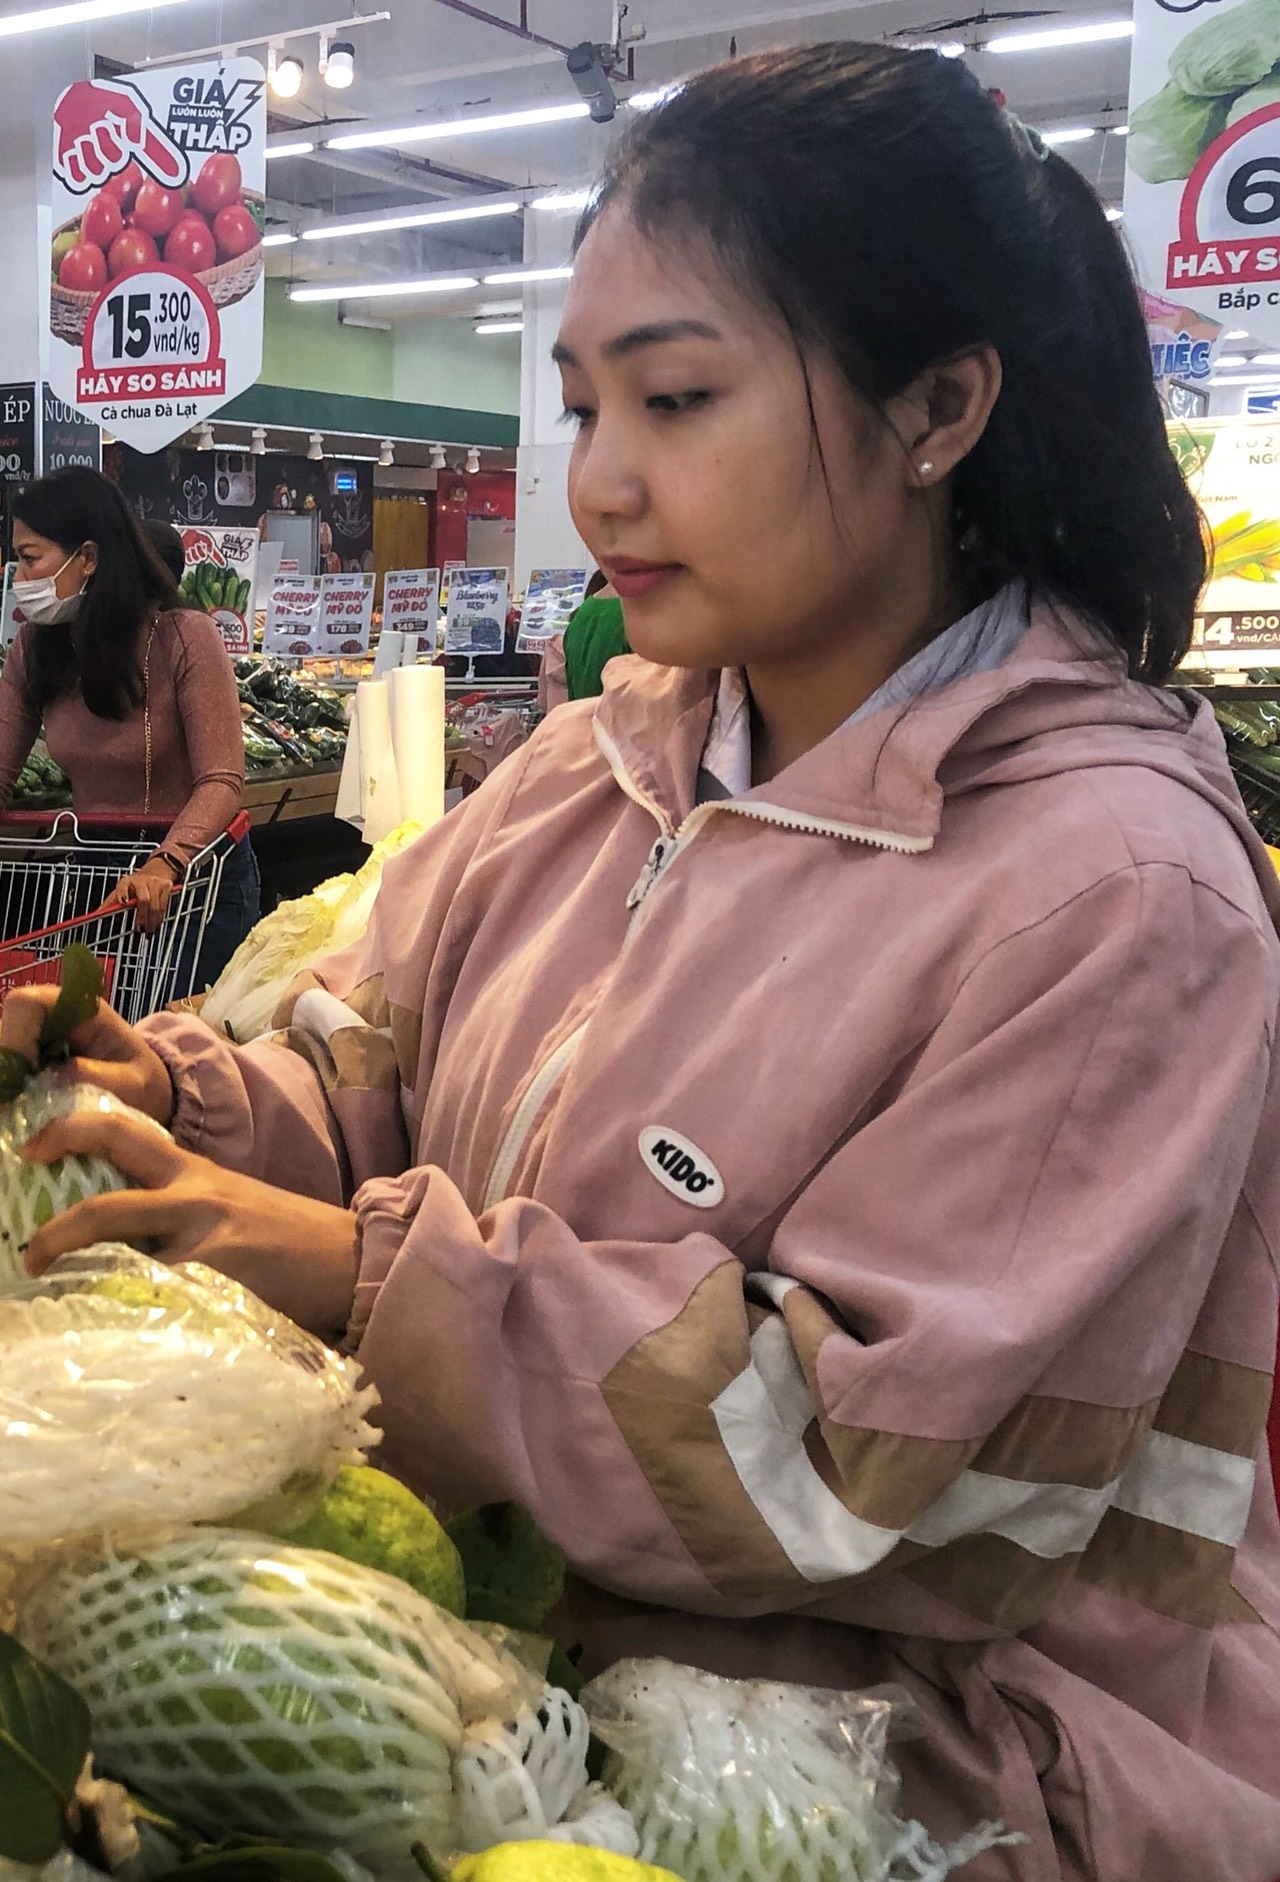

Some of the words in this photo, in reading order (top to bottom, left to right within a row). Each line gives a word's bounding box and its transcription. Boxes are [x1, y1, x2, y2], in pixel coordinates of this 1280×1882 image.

[173, 67, 227, 105] GIÁ
[171, 105, 197, 117] LUÔN
[197, 106, 223, 119] LUÔN
[1172, 247, 1250, 279] HÃY
[1255, 247, 1280, 272] S
[1218, 287, 1260, 310] Bắp
[107, 293, 151, 359] 15
[153, 324, 200, 356] vnd/kg
[80, 372, 124, 396] HÃY
[127, 373, 157, 393] SO
[160, 367, 222, 391] SÁNH
[4, 394, 31, 423] ÉP
[101, 404, 117, 420] Cà
[121, 405, 151, 419] chua
[155, 403, 173, 418] Đà
[177, 402, 198, 419] Lạt
[273, 591, 319, 602] CHERRY
[323, 590, 369, 602] CHERRY
[388, 587, 433, 600] CHERRY
